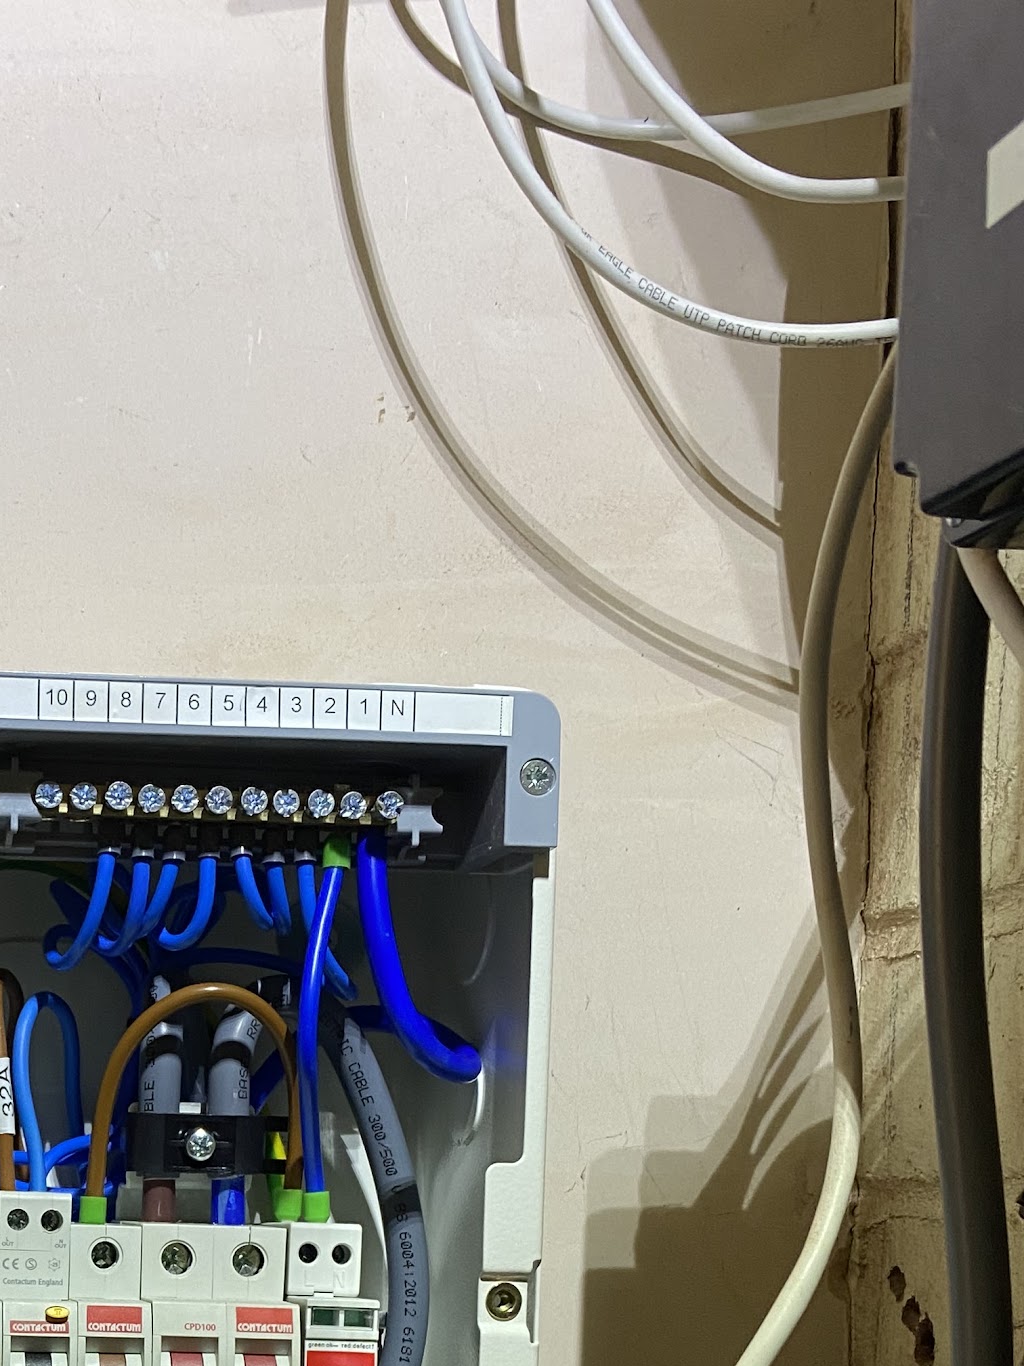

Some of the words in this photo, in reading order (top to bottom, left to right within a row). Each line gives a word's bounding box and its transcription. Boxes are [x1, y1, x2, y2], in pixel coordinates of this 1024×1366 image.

[638, 277, 678, 310] CABLE
[684, 305, 709, 325] UTP
[717, 318, 762, 341] PATCH
[47, 689, 67, 705] 10
[86, 690, 96, 706] 9
[121, 692, 131, 707] 8
[156, 693, 166, 708] 7
[189, 694, 199, 710] 6
[224, 695, 233, 710] 5
[257, 697, 267, 712] 4
[292, 697, 301, 712] 3
[325, 698, 335, 713] 2
[361, 699, 366, 714] 1
[392, 700, 404, 715] N
[348, 1062, 374, 1107] CABLE
[368, 1116, 397, 1176] 300/500
[399, 1232, 416, 1316] 6004:2012
[38, 1278, 63, 1287] England
[12, 1323, 66, 1332] CONTACTUM
[88, 1323, 141, 1332] CONTACTUM
[184, 1323, 216, 1331] CPD100
[237, 1323, 293, 1333] CONTACTUM
